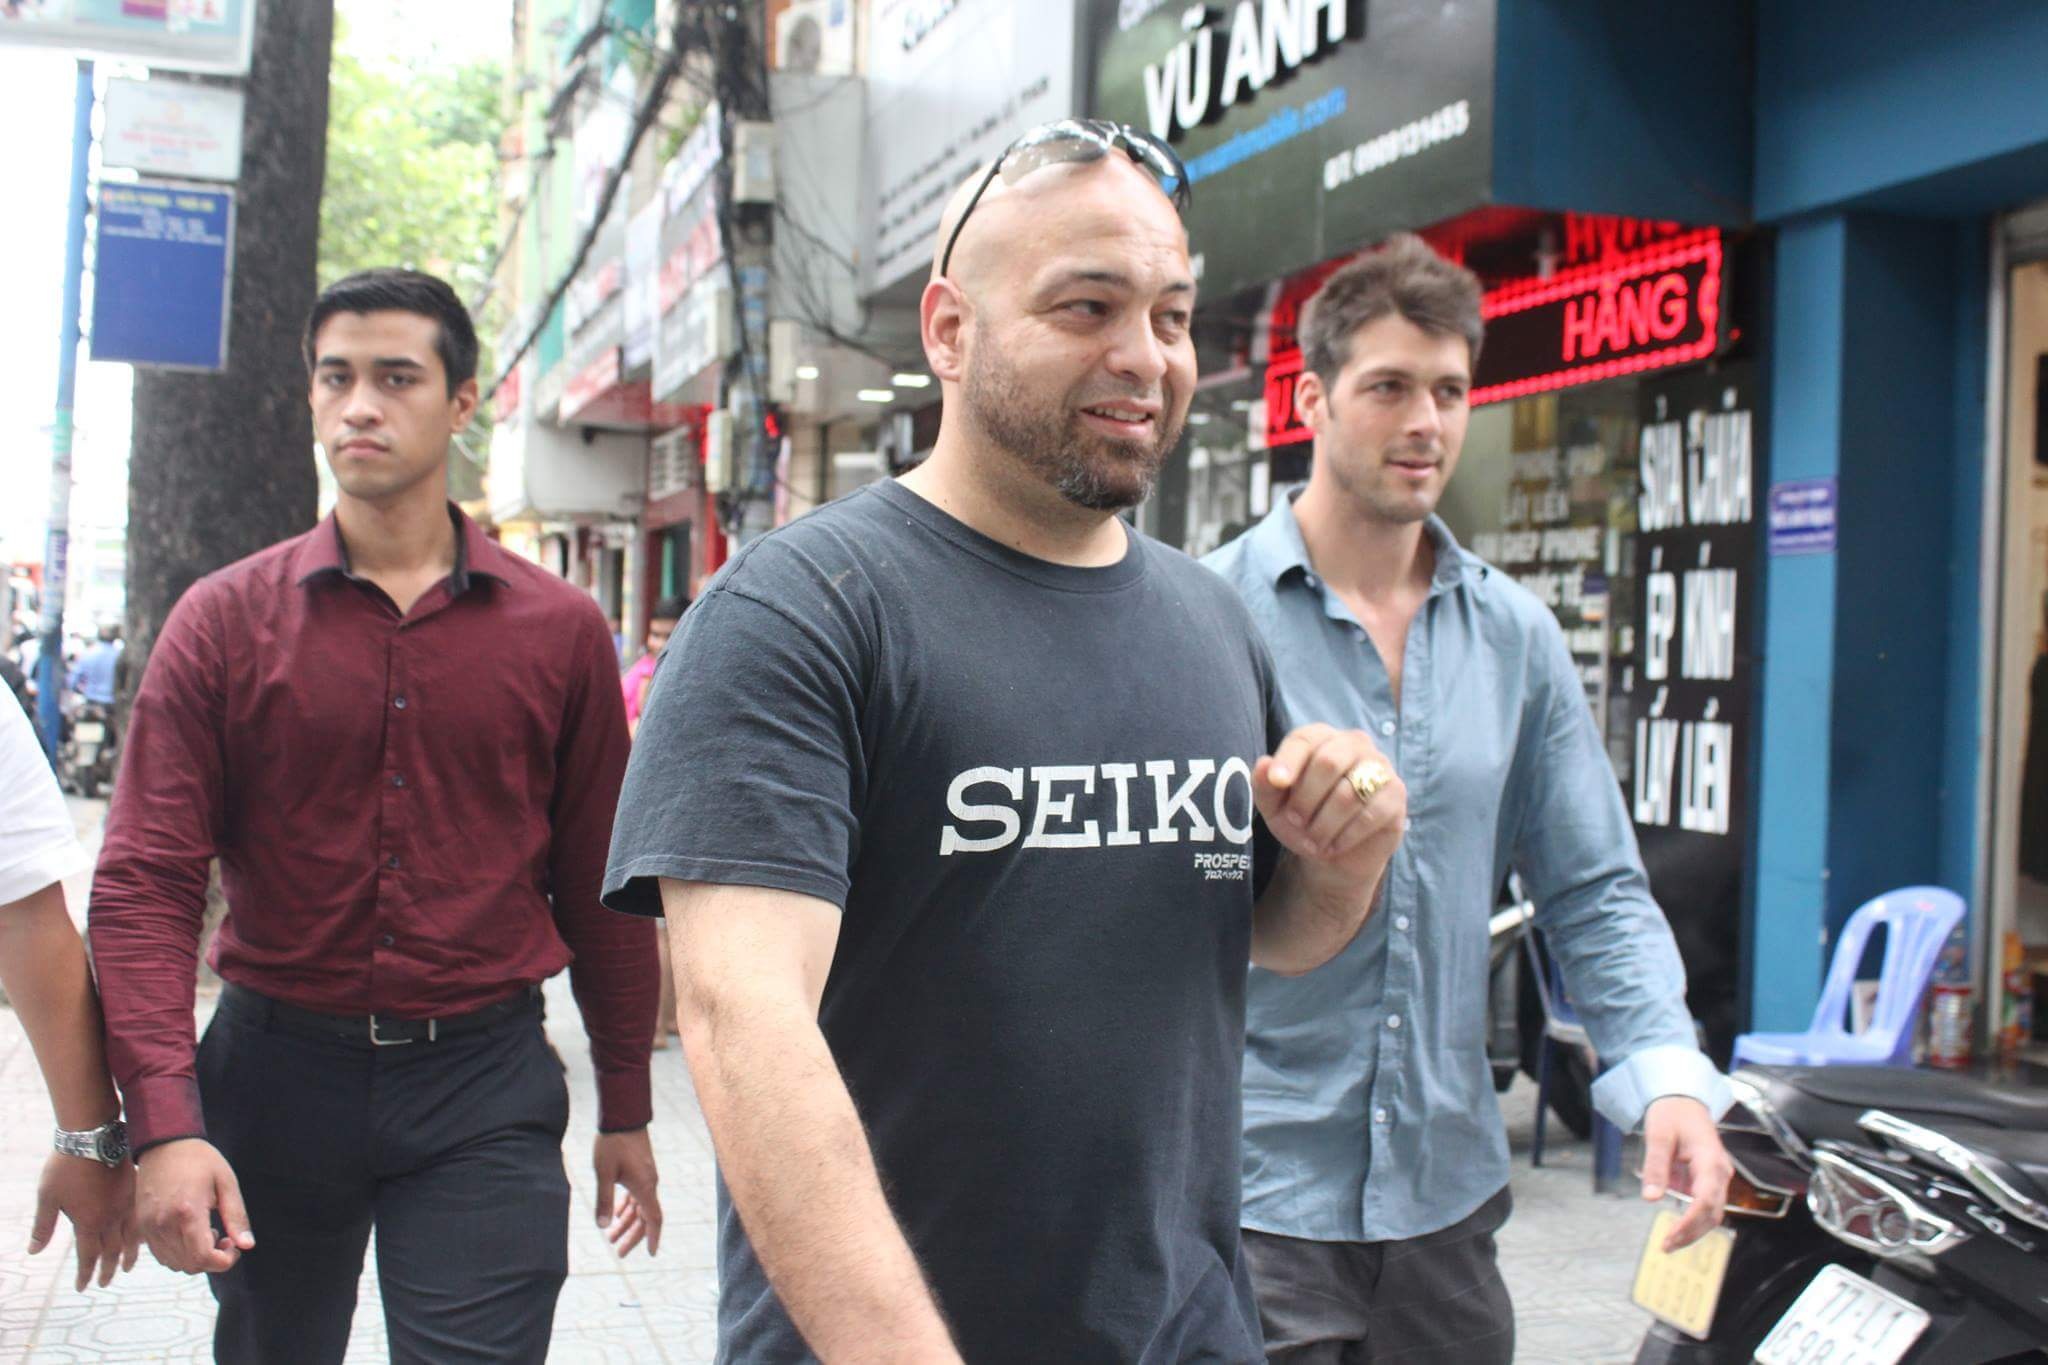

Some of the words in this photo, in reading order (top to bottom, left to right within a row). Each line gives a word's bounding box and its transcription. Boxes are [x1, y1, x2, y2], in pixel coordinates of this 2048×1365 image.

[1219, 0, 1347, 107] ANH
[939, 756, 1254, 856] SEIKO
[1194, 852, 1252, 870] PROSPE
